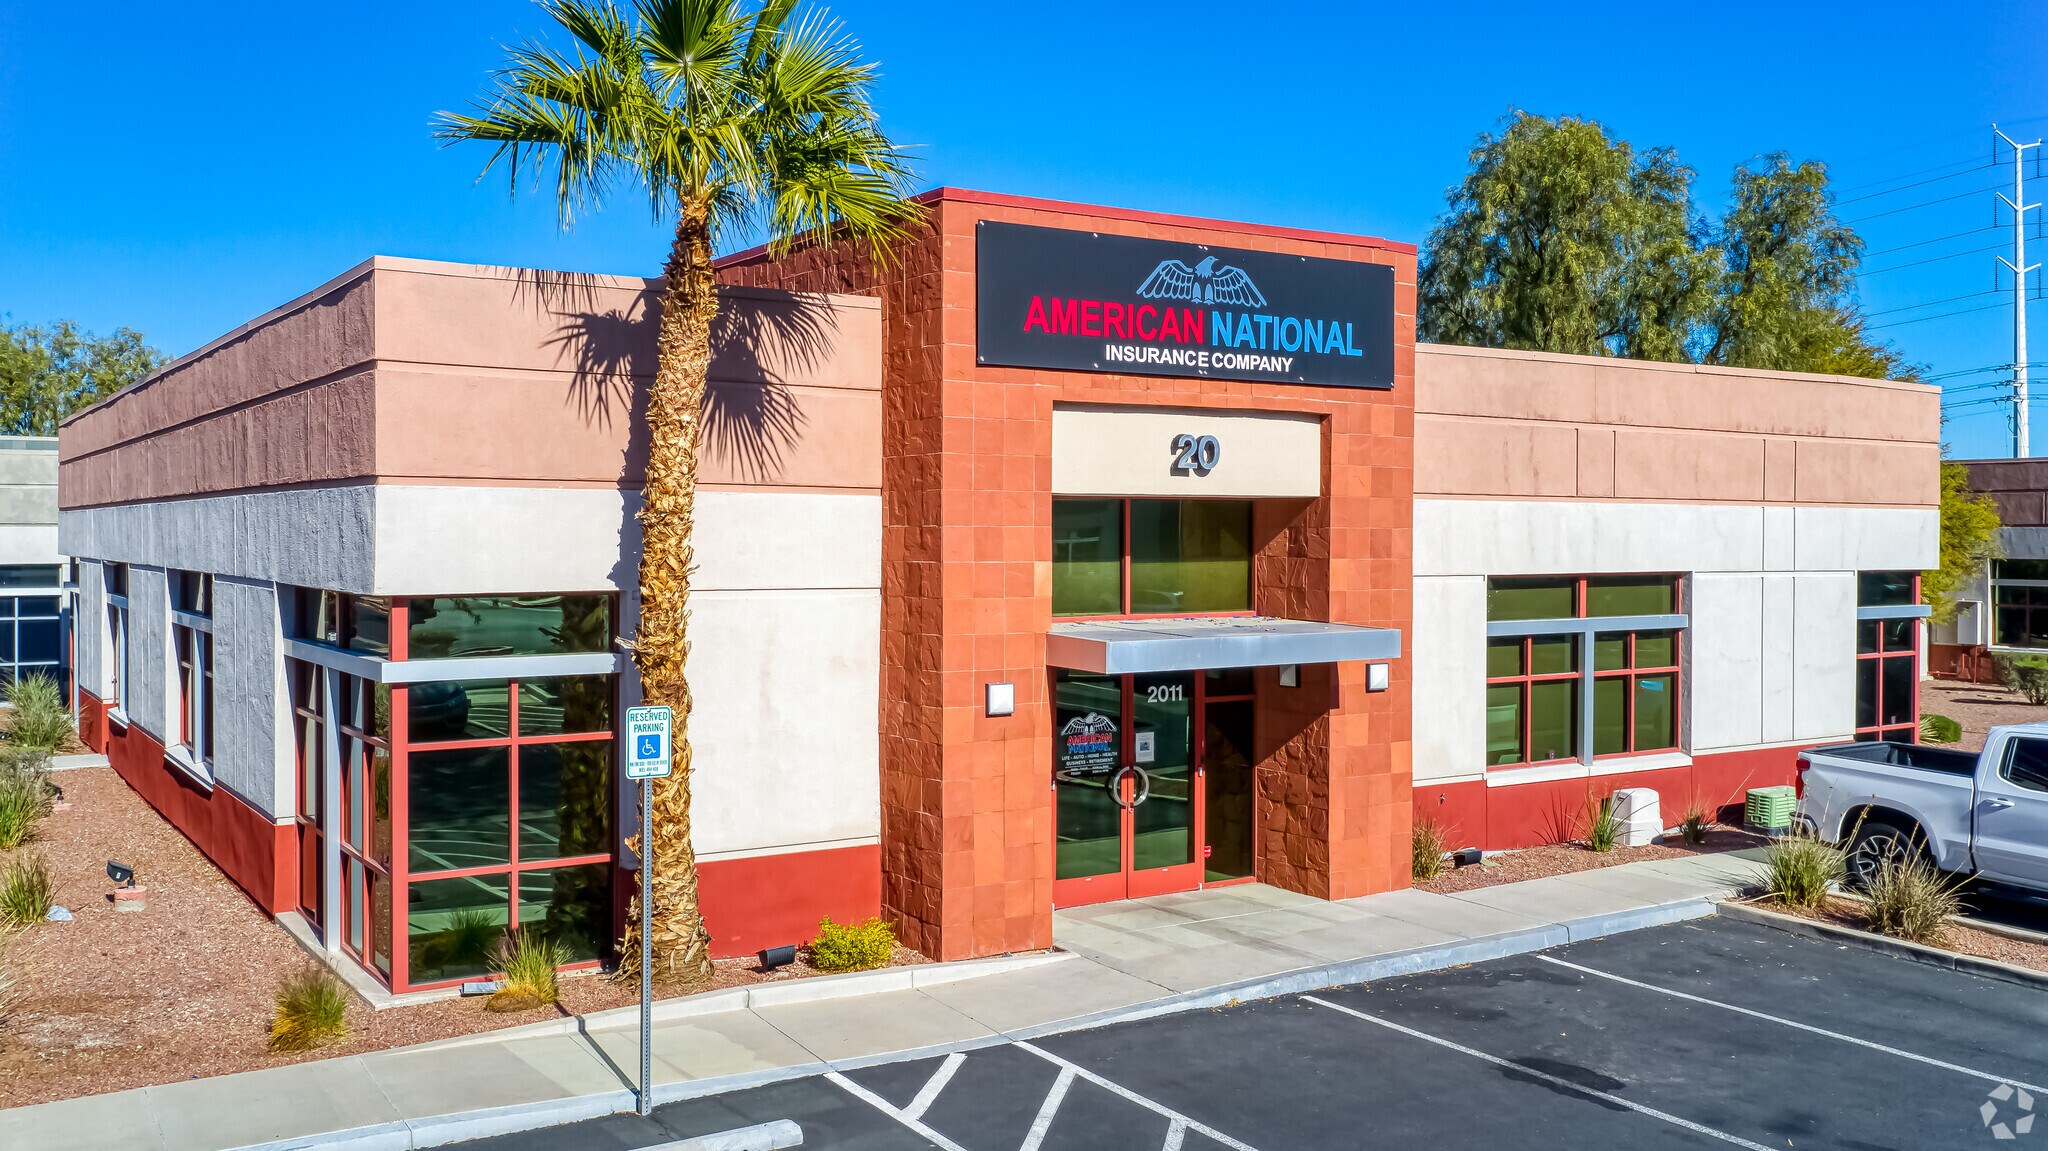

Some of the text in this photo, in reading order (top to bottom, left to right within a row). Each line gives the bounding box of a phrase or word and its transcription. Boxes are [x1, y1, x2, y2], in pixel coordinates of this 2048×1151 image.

[1023, 295, 1363, 357] AMERICAN NATIONAL
[1105, 344, 1294, 373] INSURANCE COMPANY
[1175, 433, 1220, 471] 20
[1147, 684, 1183, 703] 2011
[630, 711, 668, 722] RESERVED
[633, 722, 664, 733] PARKING
[1067, 733, 1113, 746] AMERICAN
